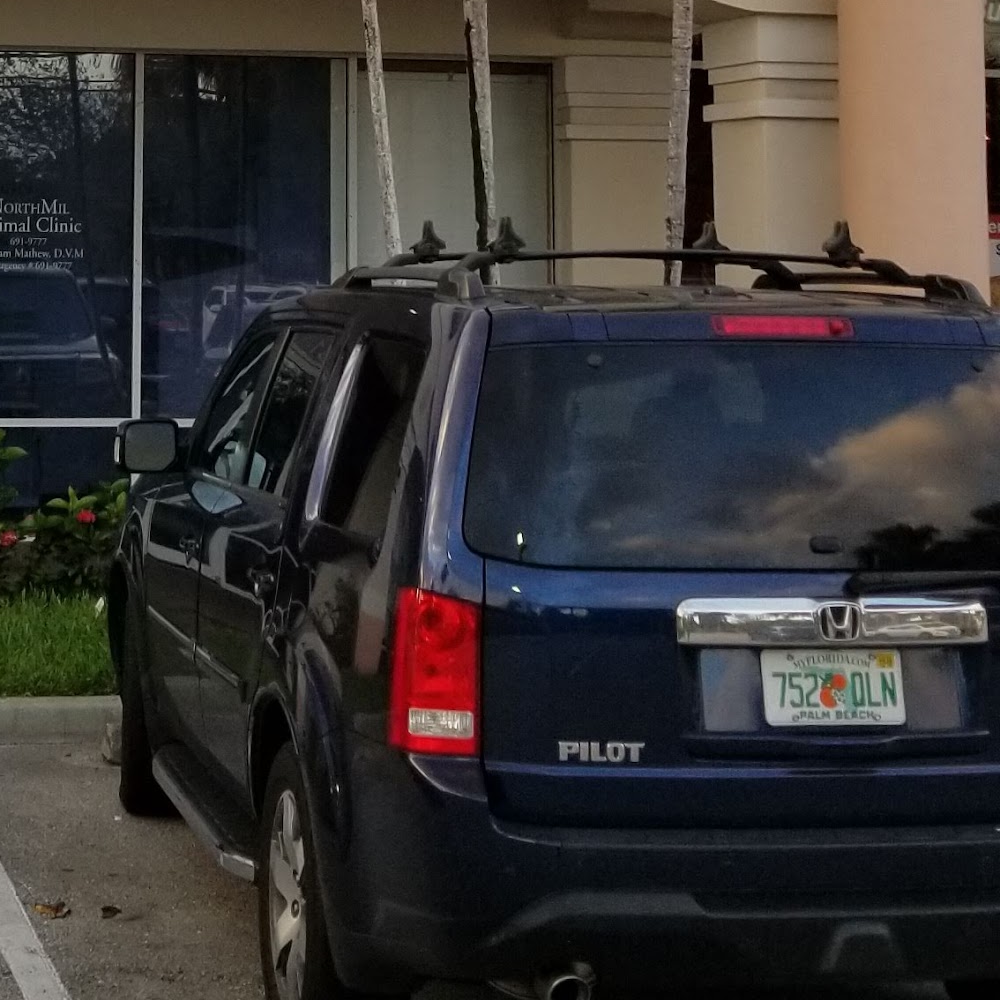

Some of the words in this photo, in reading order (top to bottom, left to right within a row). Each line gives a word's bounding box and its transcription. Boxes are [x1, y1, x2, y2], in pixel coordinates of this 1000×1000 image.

[36, 216, 82, 233] Clinic
[9, 237, 48, 247] 691-9777
[772, 672, 820, 708] 752
[799, 709, 831, 721] PALM
[835, 710, 875, 721] BEACH
[558, 741, 646, 763] PILOT
